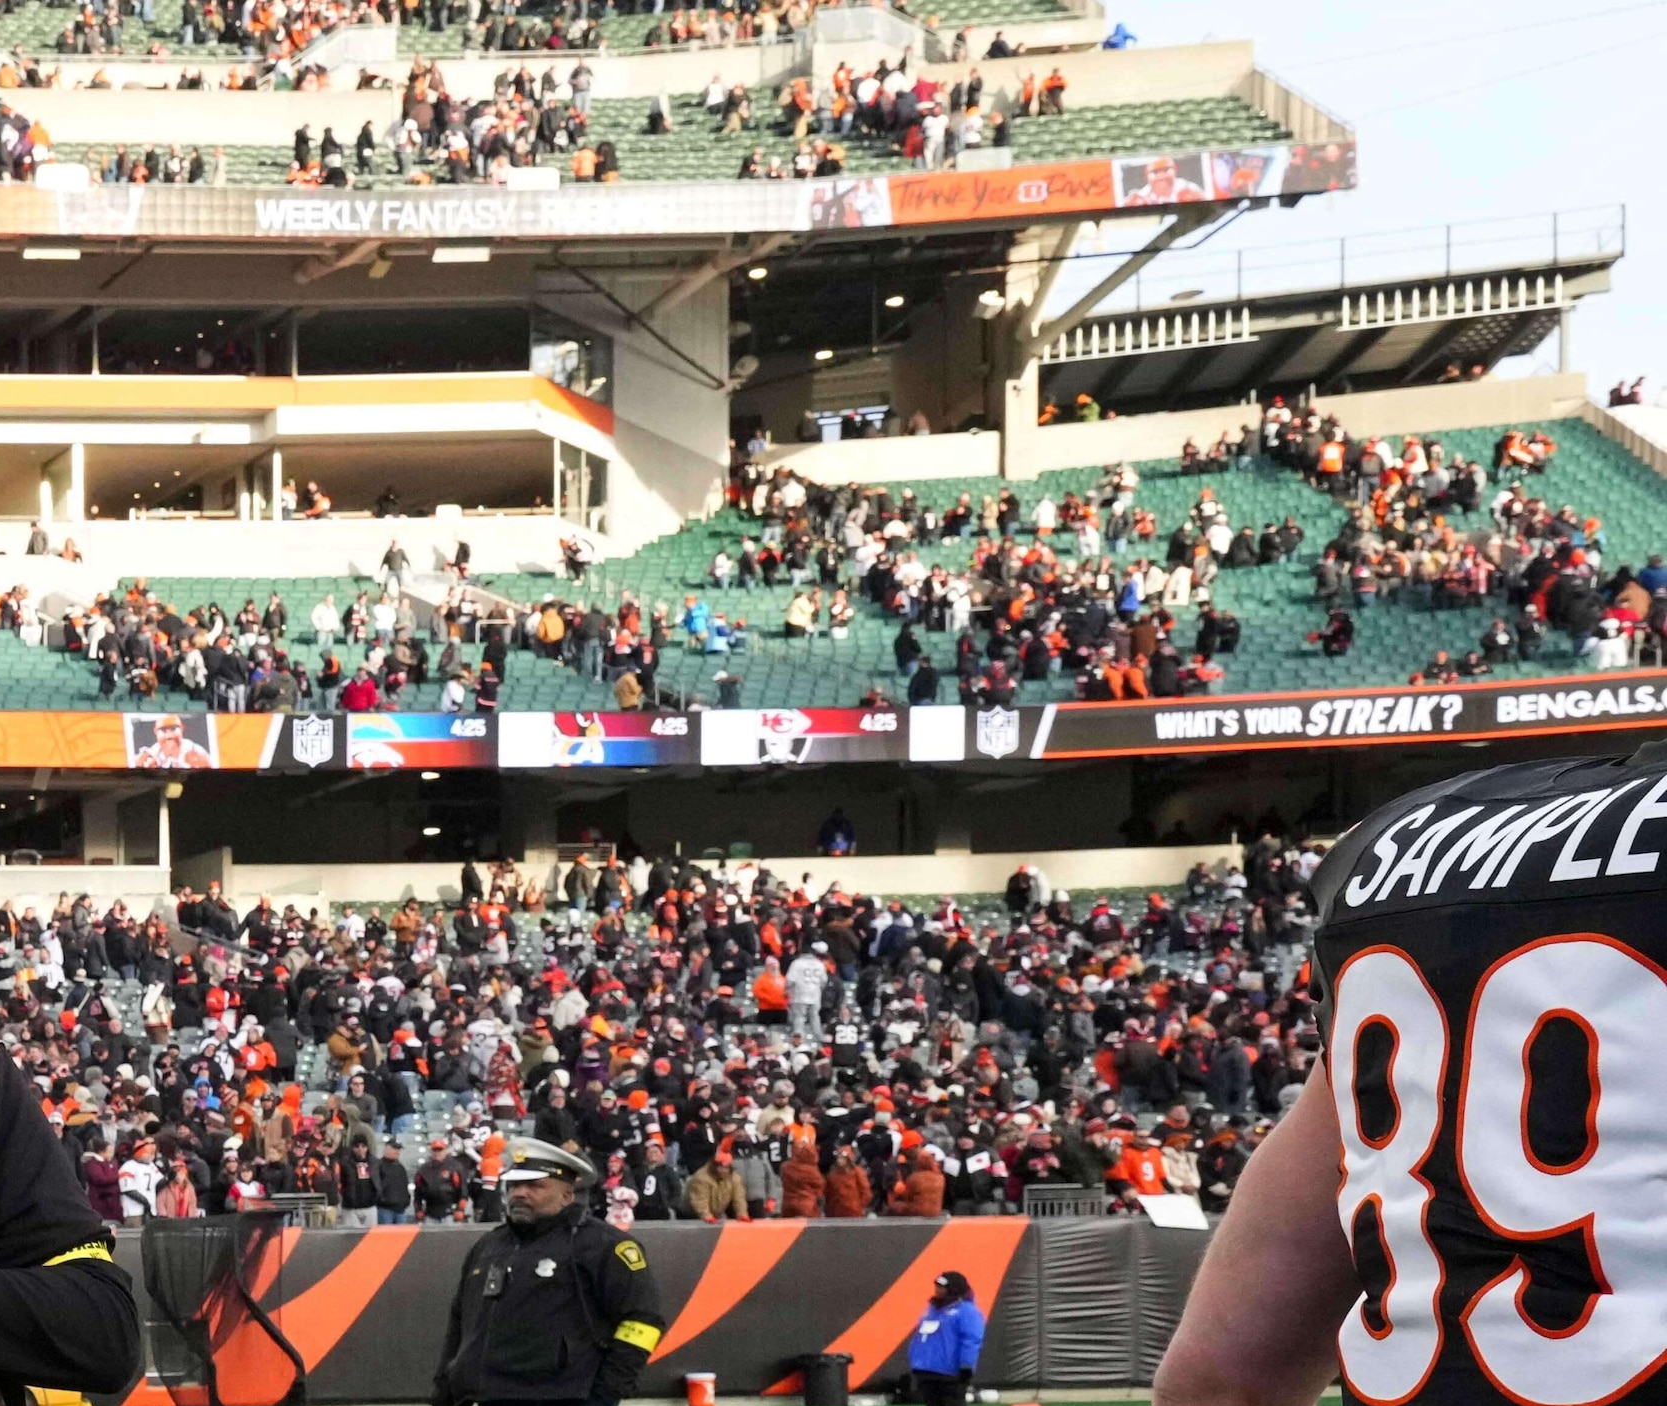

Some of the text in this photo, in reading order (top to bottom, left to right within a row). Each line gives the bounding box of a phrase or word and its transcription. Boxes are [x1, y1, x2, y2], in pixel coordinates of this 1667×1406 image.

[255, 200, 378, 231] WEEKLY
[382, 199, 517, 230] FANTASY
[449, 717, 487, 738] 4:25
[649, 716, 689, 737] 4:25
[1154, 709, 1240, 739] WHAT'S
[1243, 706, 1304, 735] YOUR
[299, 737, 328, 758] NFL
[1344, 774, 1667, 909] SAMPLE
[144, 1172, 153, 1192] 7
[642, 1174, 657, 1196] 9
